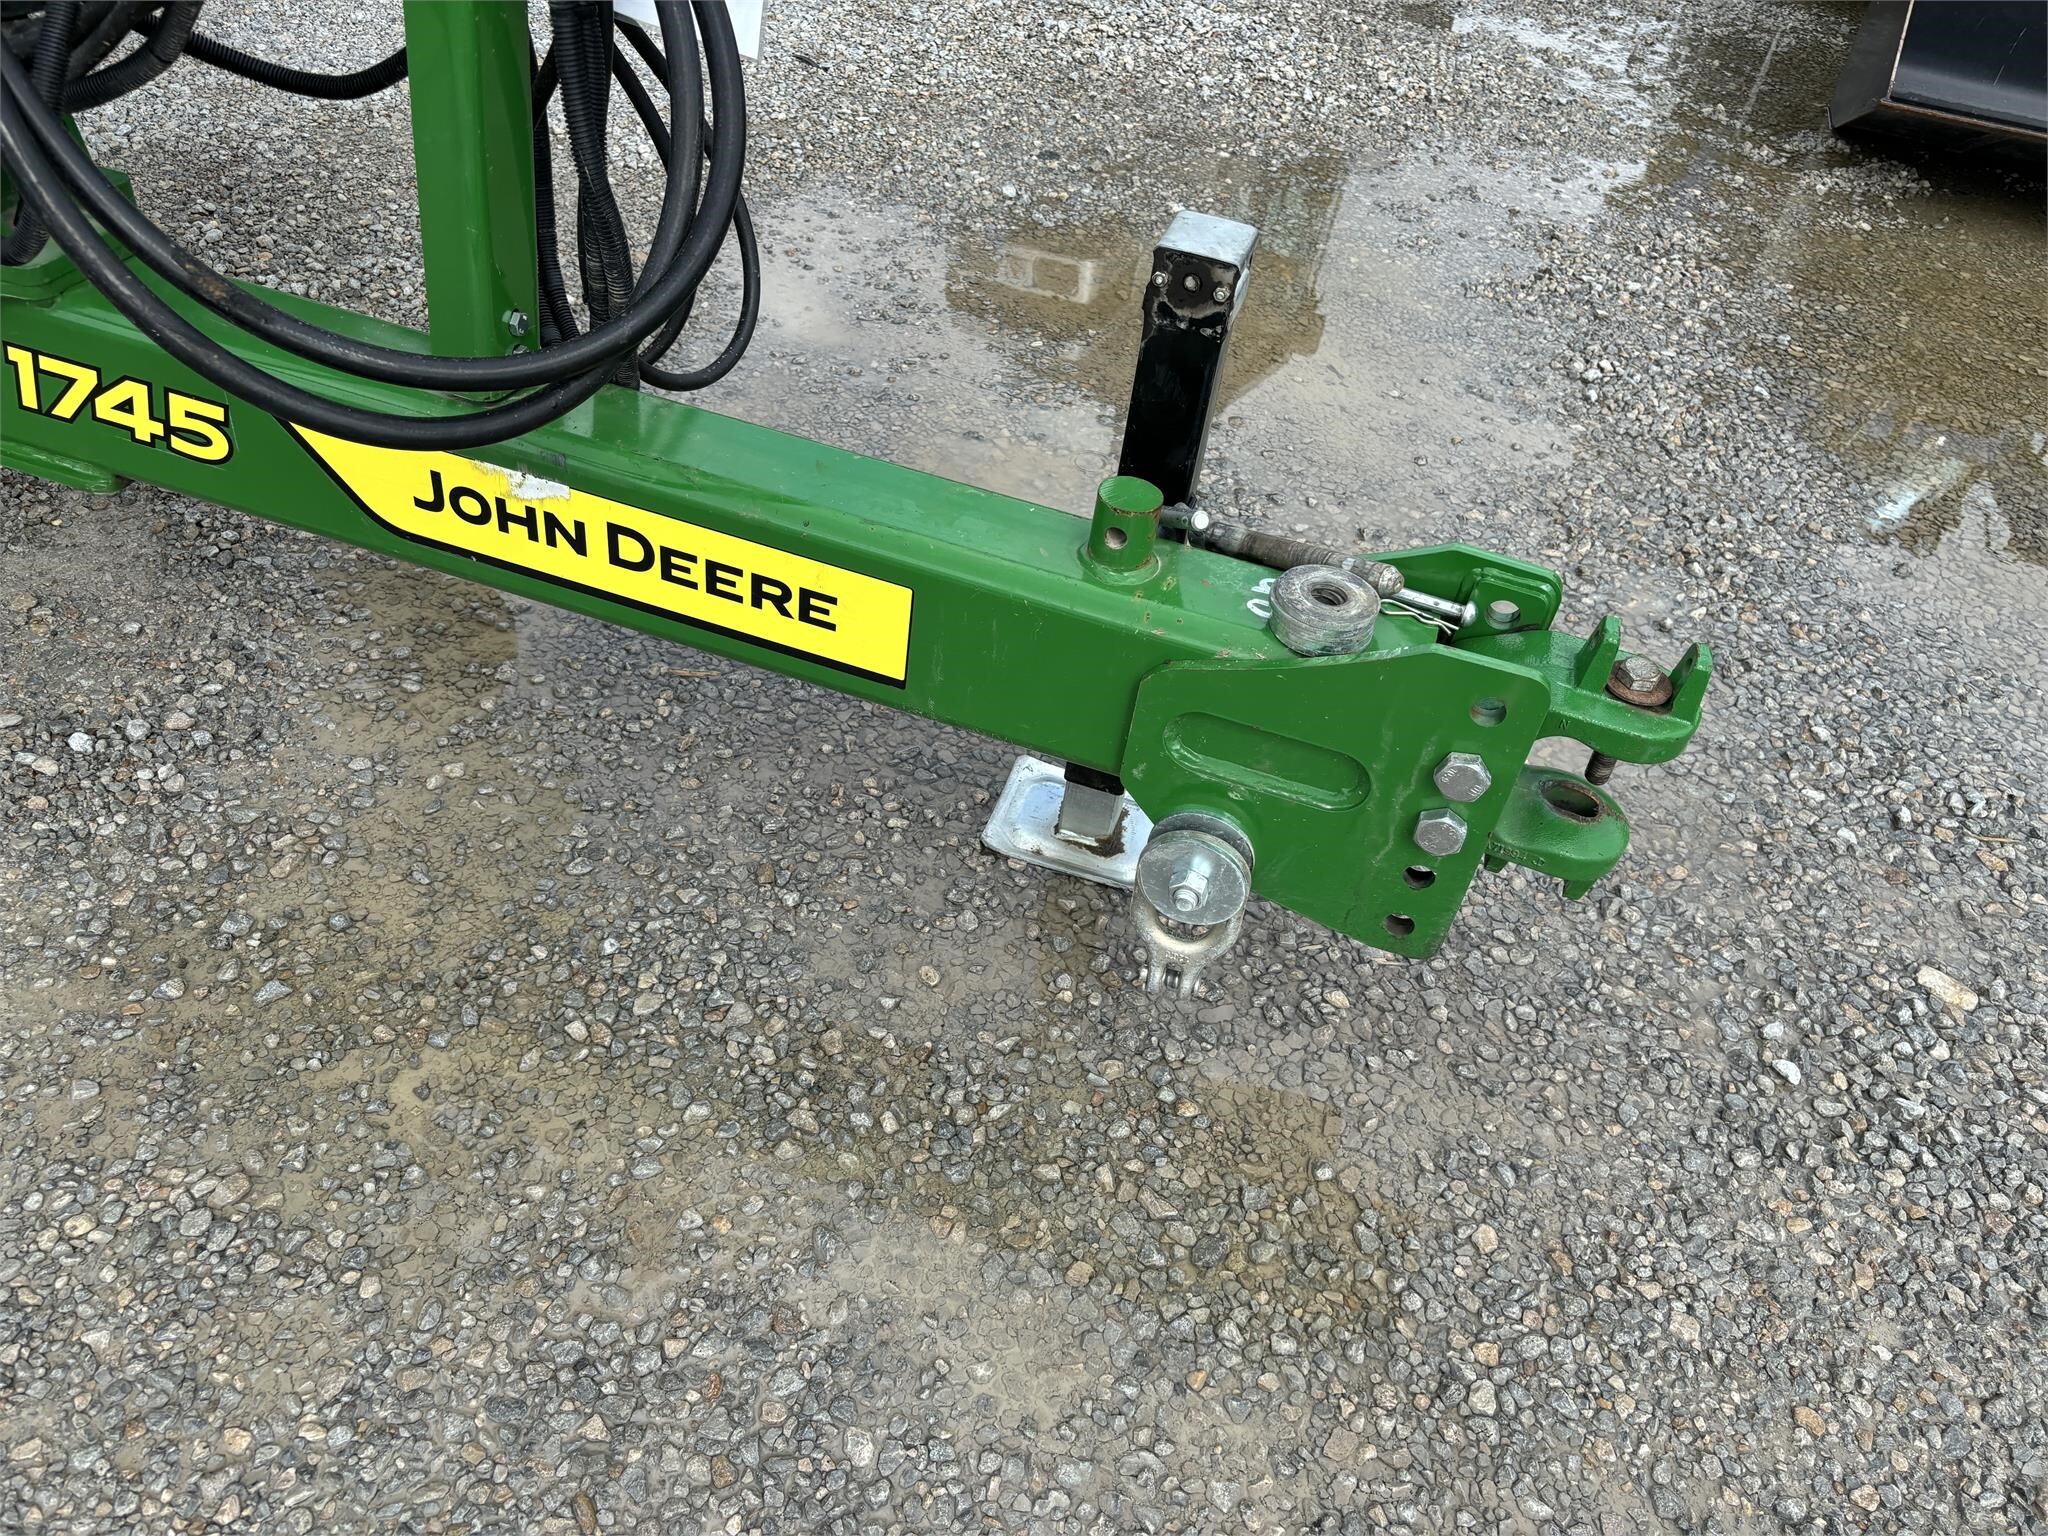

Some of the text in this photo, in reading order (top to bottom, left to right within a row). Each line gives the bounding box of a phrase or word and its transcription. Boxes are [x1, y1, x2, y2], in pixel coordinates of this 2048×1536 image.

[4, 343, 233, 464] 1745
[413, 470, 838, 632] JOHN DEERE
